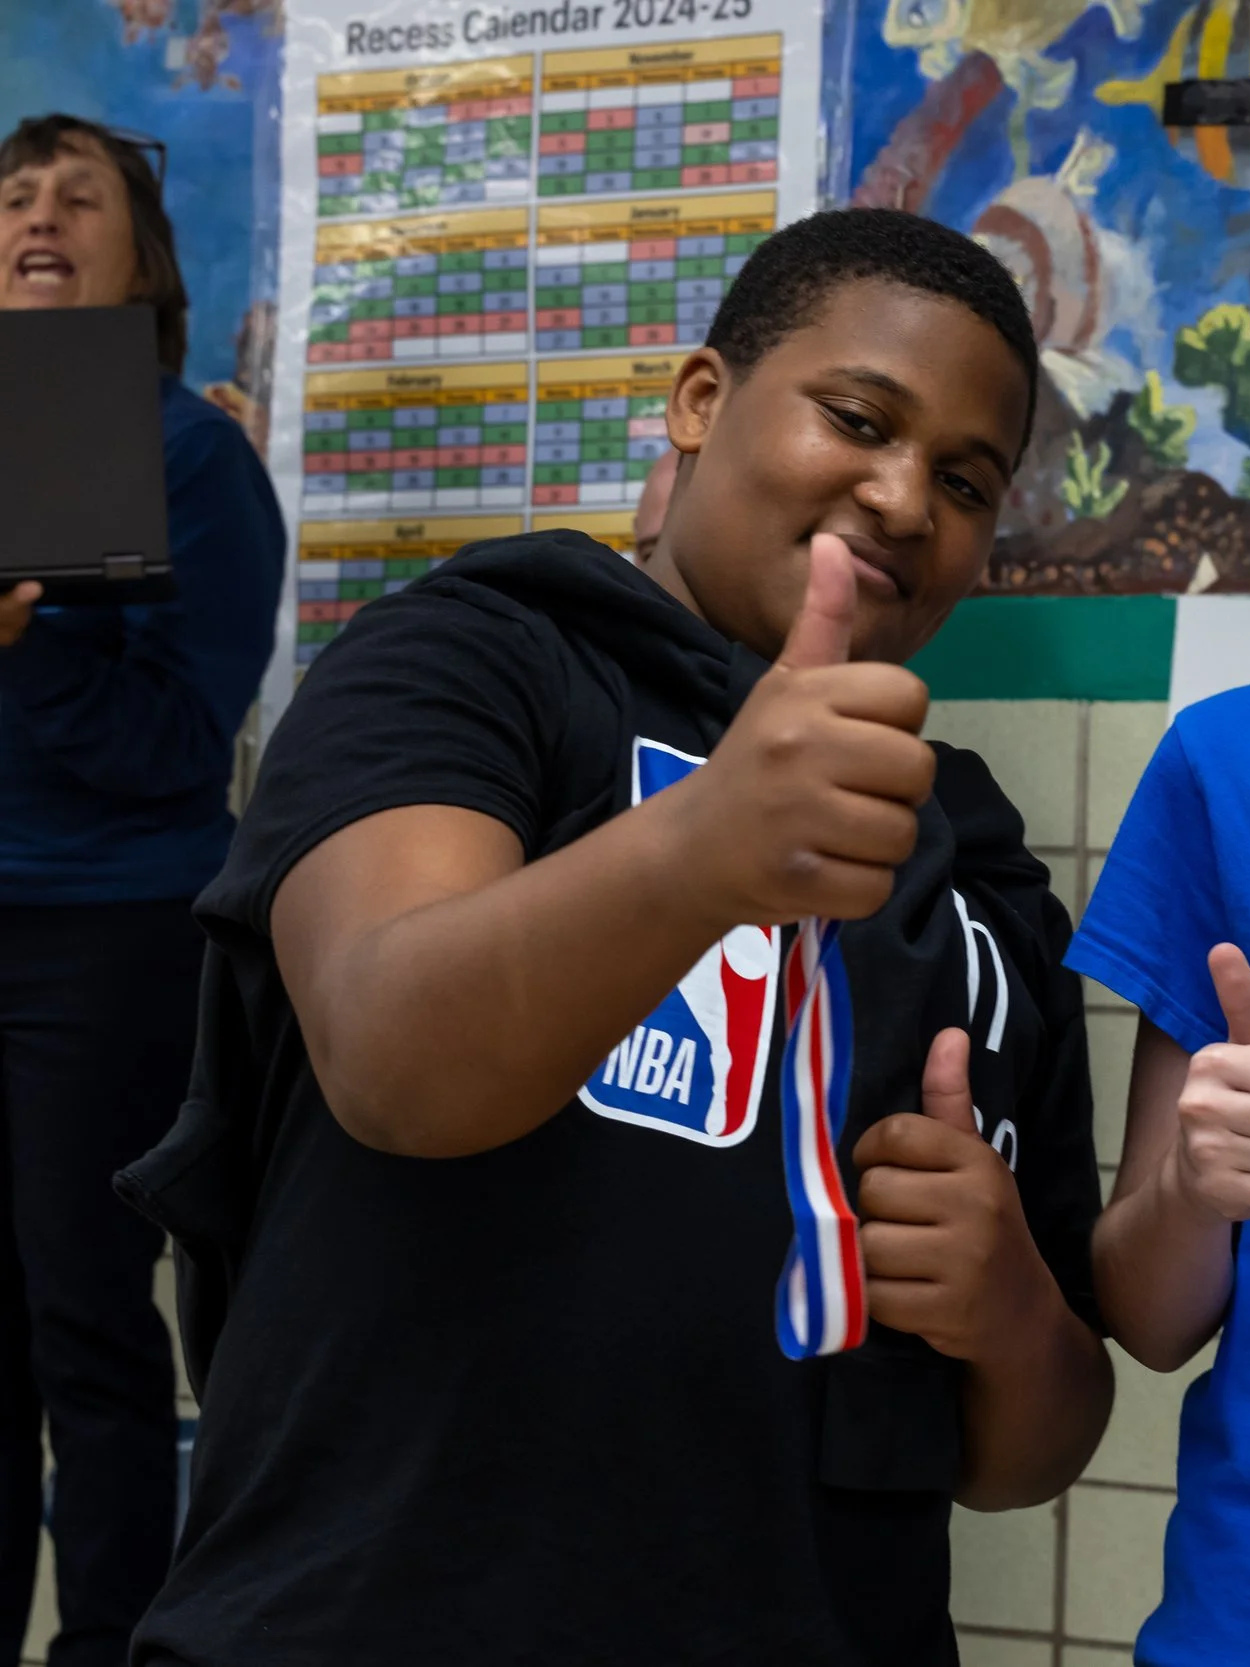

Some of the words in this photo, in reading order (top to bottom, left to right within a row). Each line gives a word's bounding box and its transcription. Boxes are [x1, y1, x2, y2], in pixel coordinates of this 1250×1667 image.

[346, 20, 455, 55] Recess
[463, 0, 603, 44] Calendar
[613, 0, 752, 29] 2024-25
[602, 1025, 696, 1105] NBA
